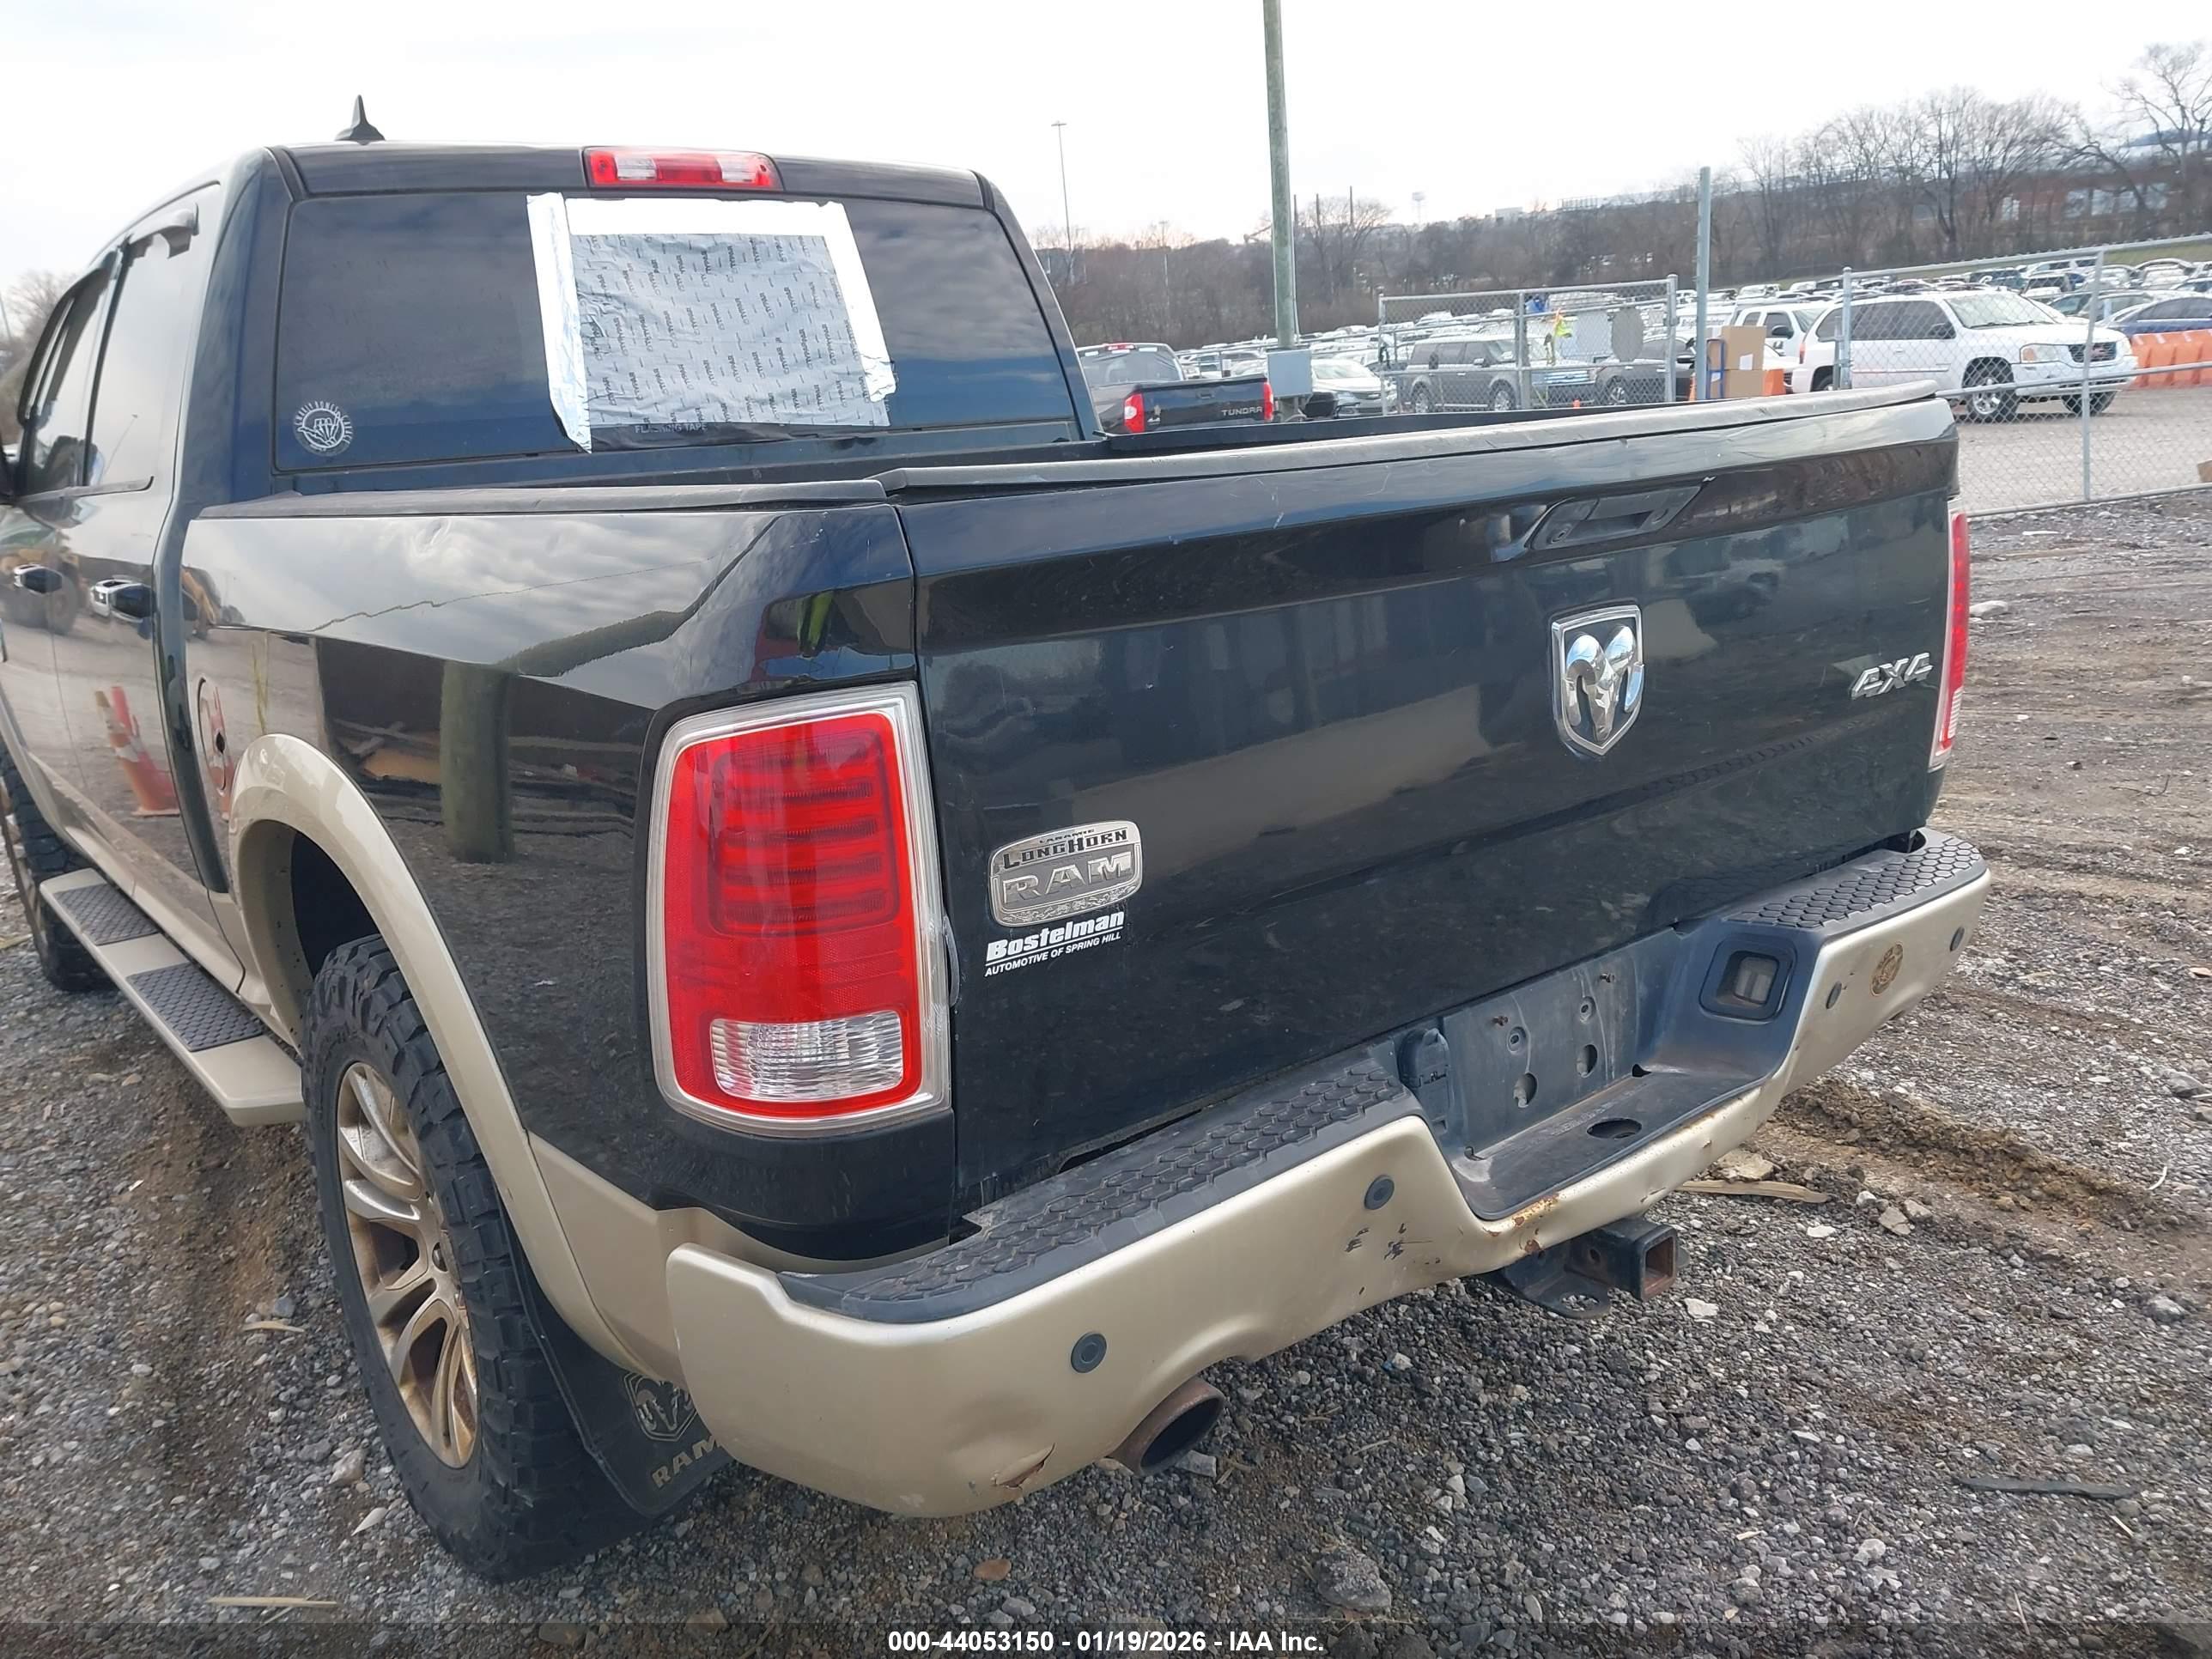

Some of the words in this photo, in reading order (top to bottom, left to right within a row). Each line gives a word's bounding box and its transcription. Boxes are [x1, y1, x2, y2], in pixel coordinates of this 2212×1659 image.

[1221, 406, 1263, 416] TUNDRA
[1002, 851, 1132, 903] RAM
[984, 951, 1048, 977] AUTOMOTIVE
[1050, 947, 1064, 958] OF
[1065, 939, 1100, 954] SPRING
[1102, 932, 1121, 944] HILL
[986, 911, 1125, 962] Bostelman
